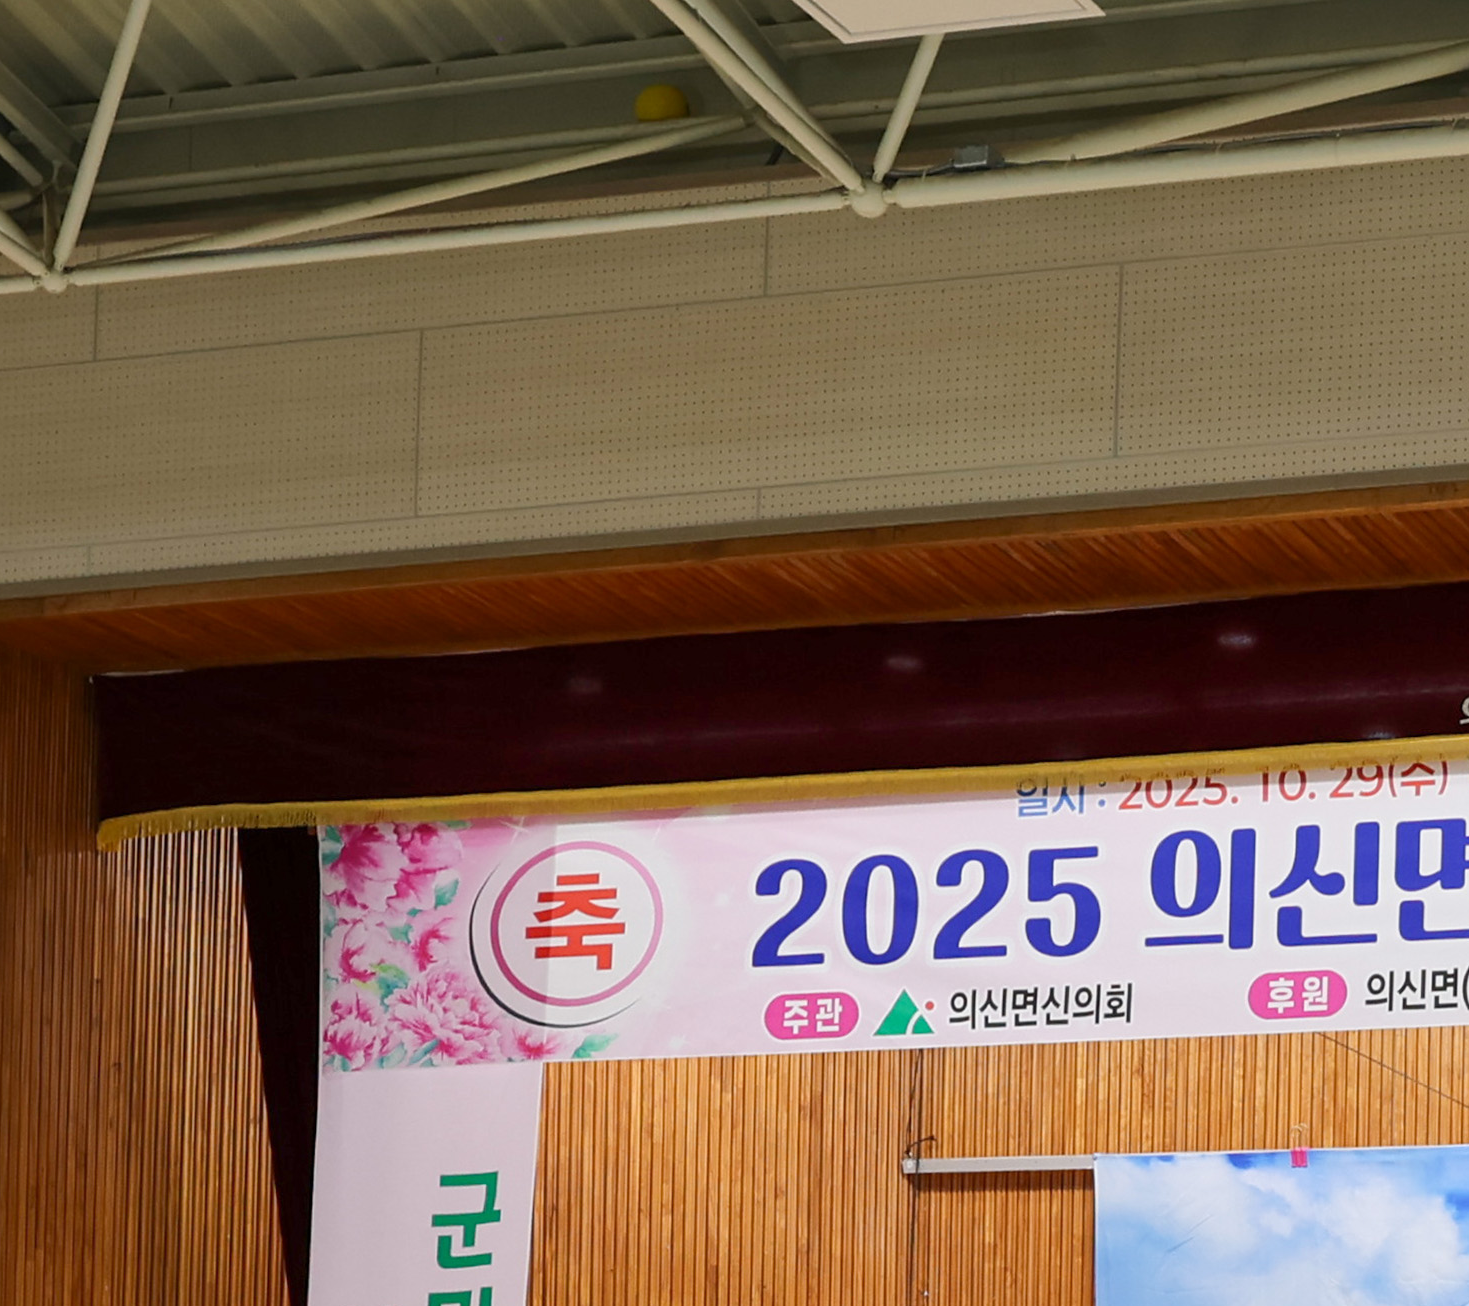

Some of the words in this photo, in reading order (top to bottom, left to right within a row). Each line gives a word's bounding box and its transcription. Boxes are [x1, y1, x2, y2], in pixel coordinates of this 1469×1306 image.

[524, 872, 627, 972] 축
[750, 844, 1101, 968] 2025
[783, 1000, 845, 1034] 주관
[949, 983, 1133, 1030] 의신면신의회
[1264, 975, 1330, 1015] 후원
